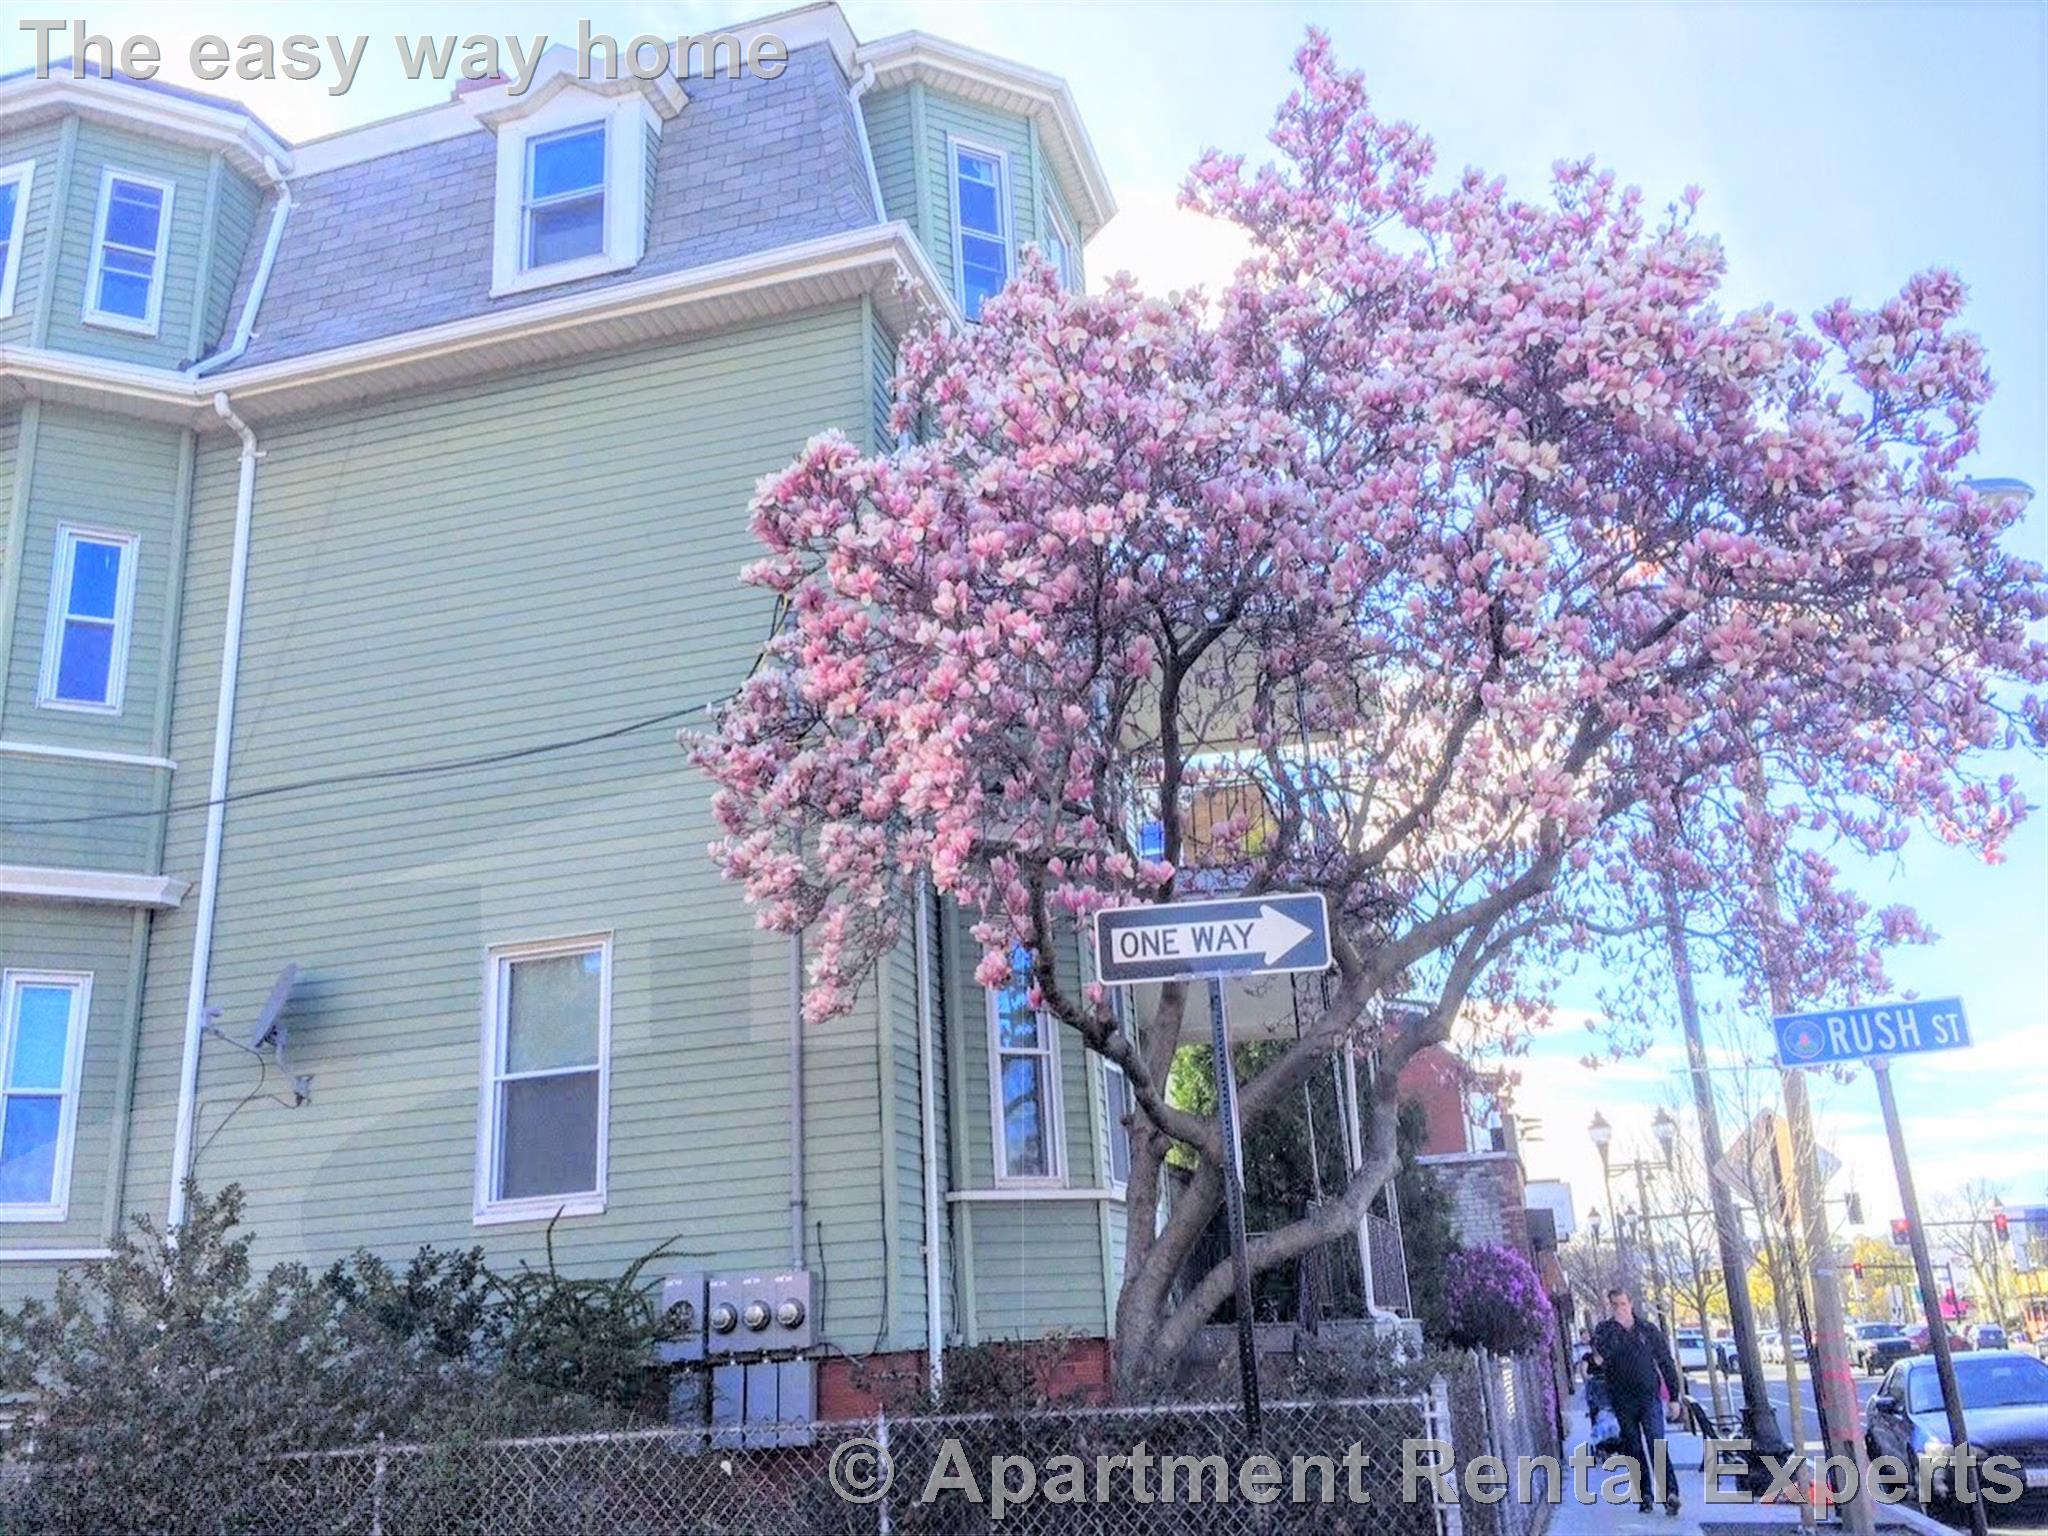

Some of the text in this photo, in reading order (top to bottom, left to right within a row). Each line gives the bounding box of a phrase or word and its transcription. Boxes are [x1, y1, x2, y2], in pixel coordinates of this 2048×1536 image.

[1120, 922, 1255, 959] ONE WAY
[1826, 1008, 1960, 1056] RUSH ST
